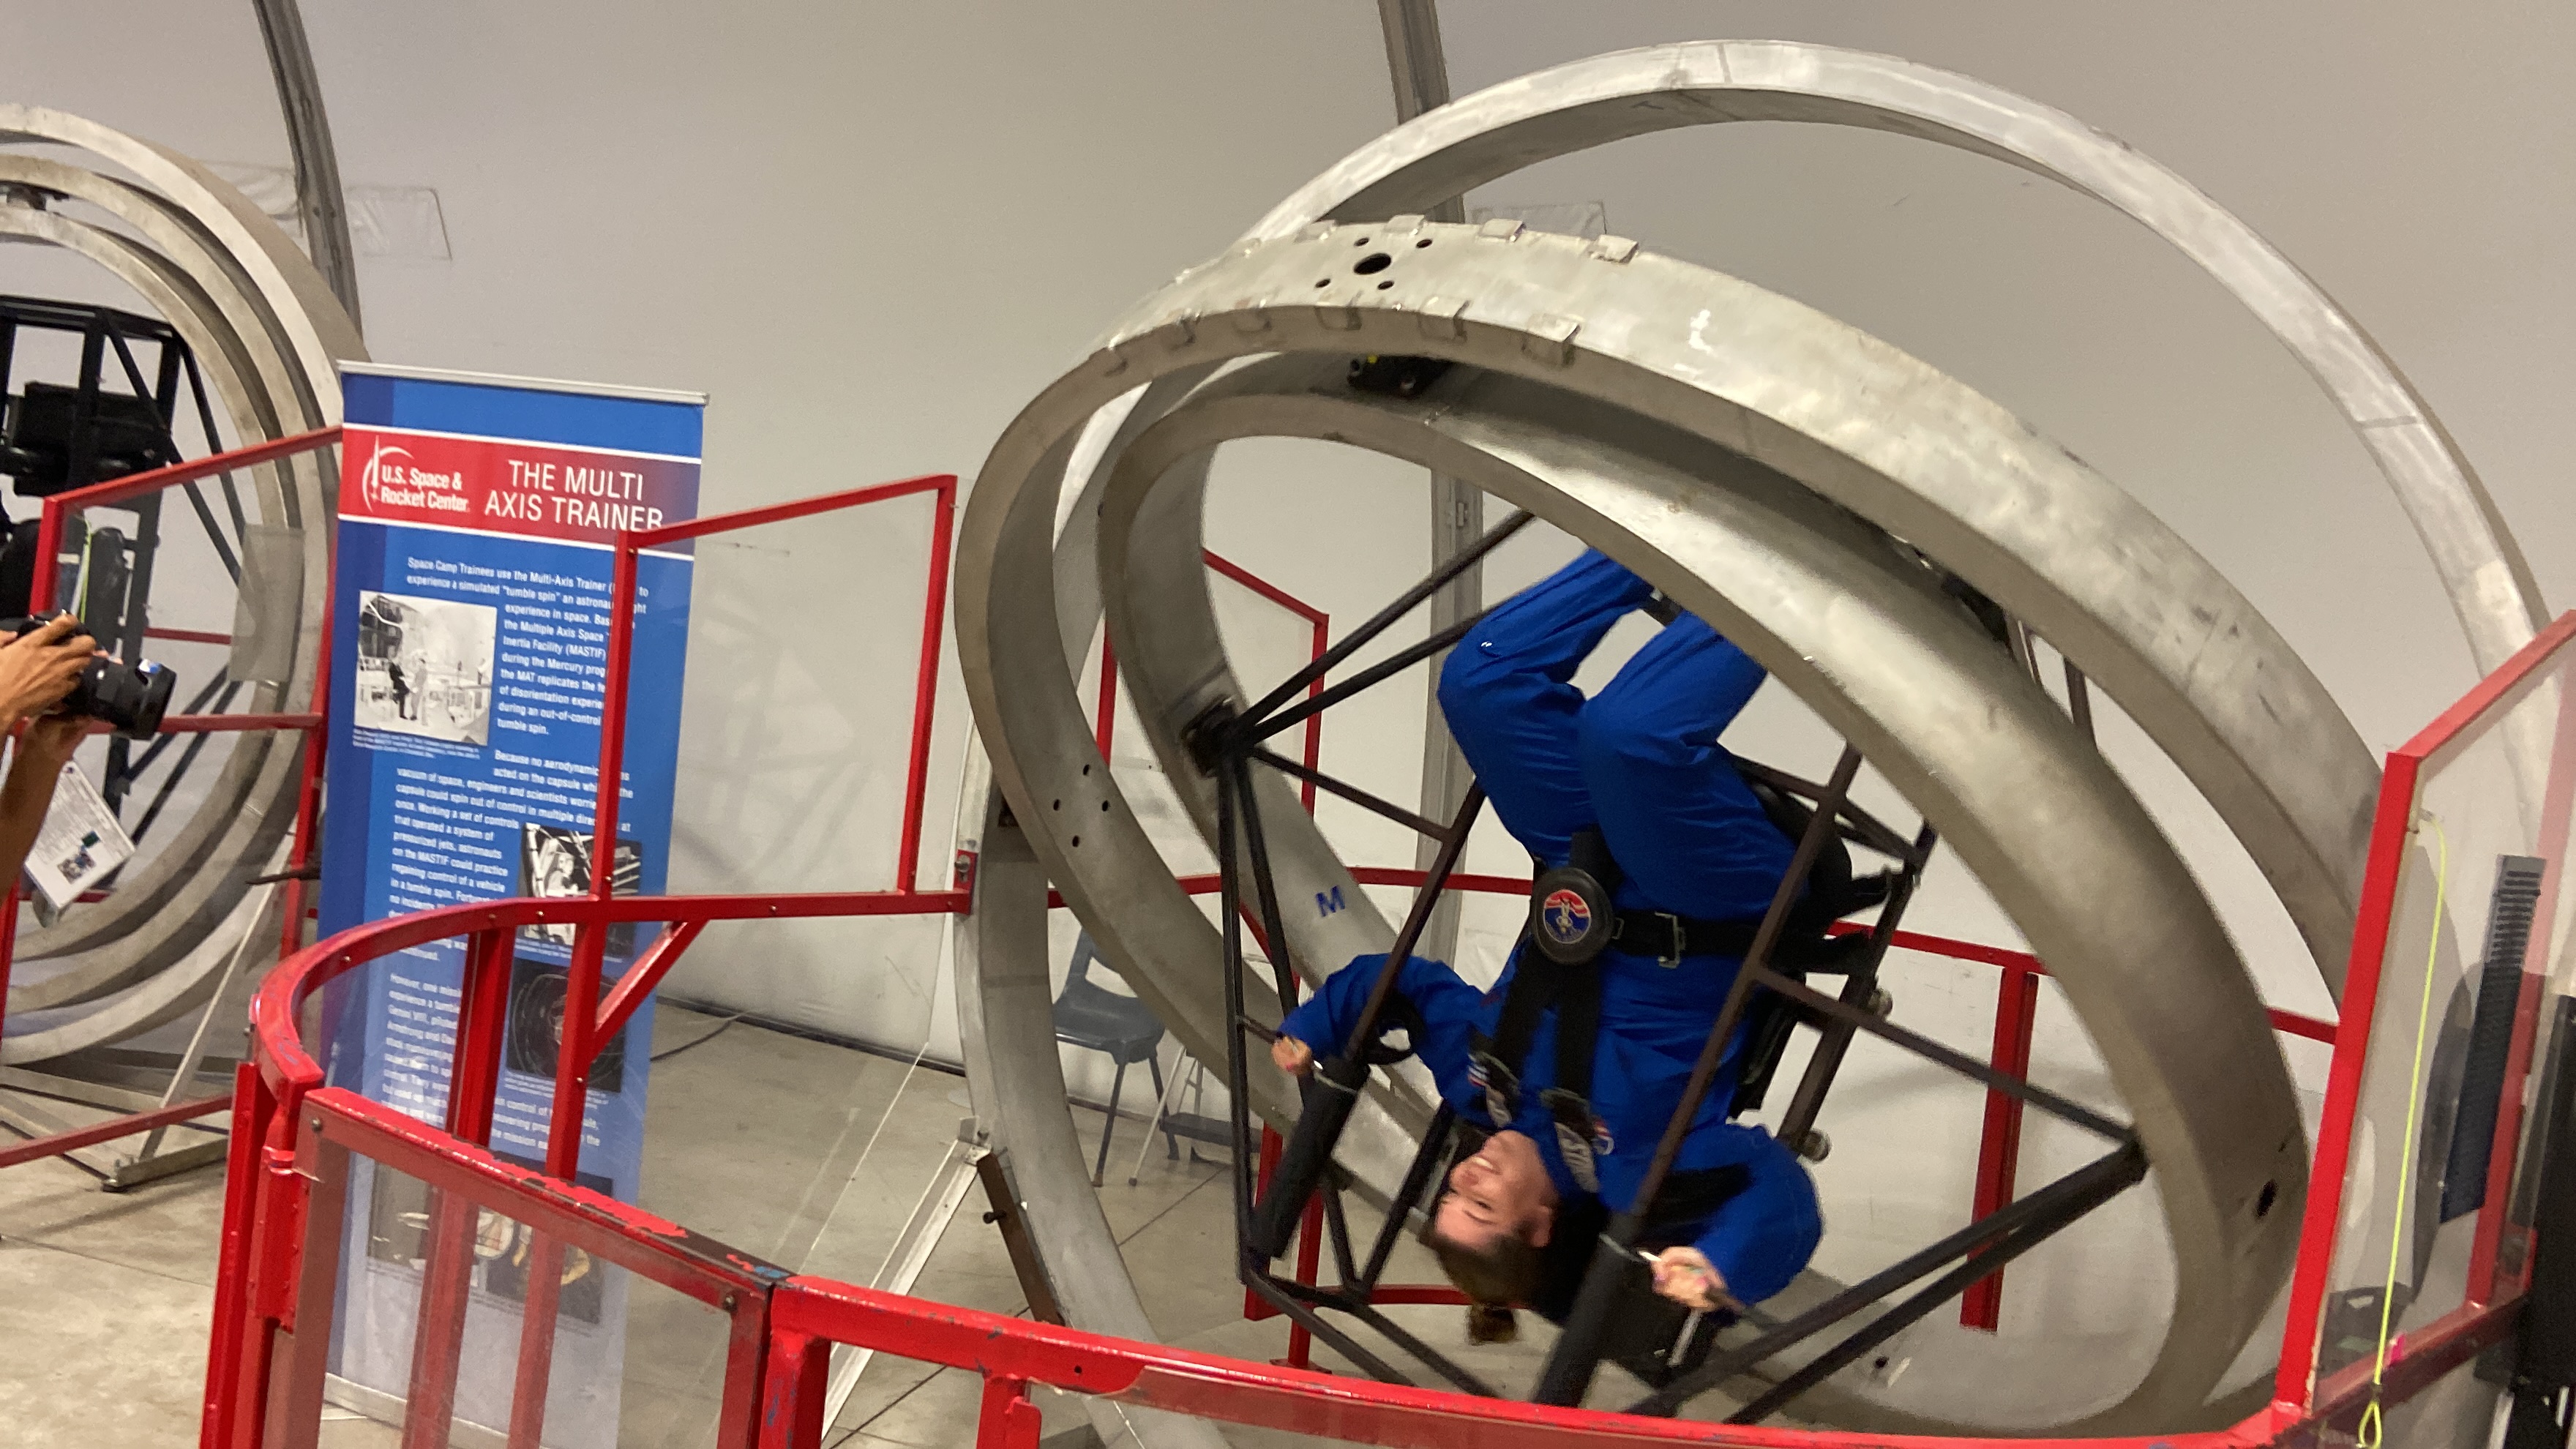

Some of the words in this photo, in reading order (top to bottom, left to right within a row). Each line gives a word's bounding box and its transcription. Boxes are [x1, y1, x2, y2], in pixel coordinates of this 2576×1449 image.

[381, 465, 406, 484] U.S.
[409, 467, 450, 490] Space
[452, 471, 463, 490] &
[508, 460, 556, 492] THE
[565, 465, 643, 501] MULTI
[381, 486, 425, 508] Rocket
[427, 490, 468, 512] Center
[484, 490, 542, 522] AXIS
[551, 496, 663, 532] TRAINER
[408, 556, 434, 570] Space
[435, 560, 457, 574] Camp
[459, 562, 495, 578] Trainees
[497, 569, 512, 580] use
[514, 570, 528, 582] the
[530, 572, 574, 588] Multi-Axis
[576, 577, 606, 591] Trainer
[639, 586, 648, 597] to
[407, 575, 450, 588] experience
[452, 580, 457, 590] a
[459, 580, 500, 595] simulated
[503, 585, 536, 599] "tumble
[563, 594, 574, 604] an
[505, 604, 550, 618] experience
[553, 609, 561, 620] in
[564, 611, 591, 624] space.
[503, 619, 517, 630] the
[520, 621, 554, 635] Multiple
[556, 626, 575, 638] Axis
[578, 628, 604, 643] Space
[503, 635, 531, 648] Inertia
[533, 639, 563, 655] Facility
[566, 644, 606, 661] (MASTIF)
[501, 652, 529, 667] during
[532, 656, 544, 667] the
[547, 658, 583, 675] Mercury
[586, 666, 605, 678] prog
[501, 668, 514, 679] the
[517, 670, 535, 682] MAT
[538, 675, 580, 689] replicates
[582, 680, 595, 691] the
[499, 685, 509, 695] of
[511, 686, 569, 704] disorientation
[498, 702, 525, 716] during
[528, 707, 539, 716] an
[540, 708, 601, 726] out-of-control
[498, 719, 526, 731] tumble
[495, 749, 529, 765] Because
[531, 757, 542, 767] no
[467, 779, 507, 794] engineers
[526, 790, 567, 805] scientists
[531, 773, 544, 785] the
[547, 776, 580, 790] capsule
[538, 806, 574, 822] multiple
[1315, 885, 1346, 917] M
